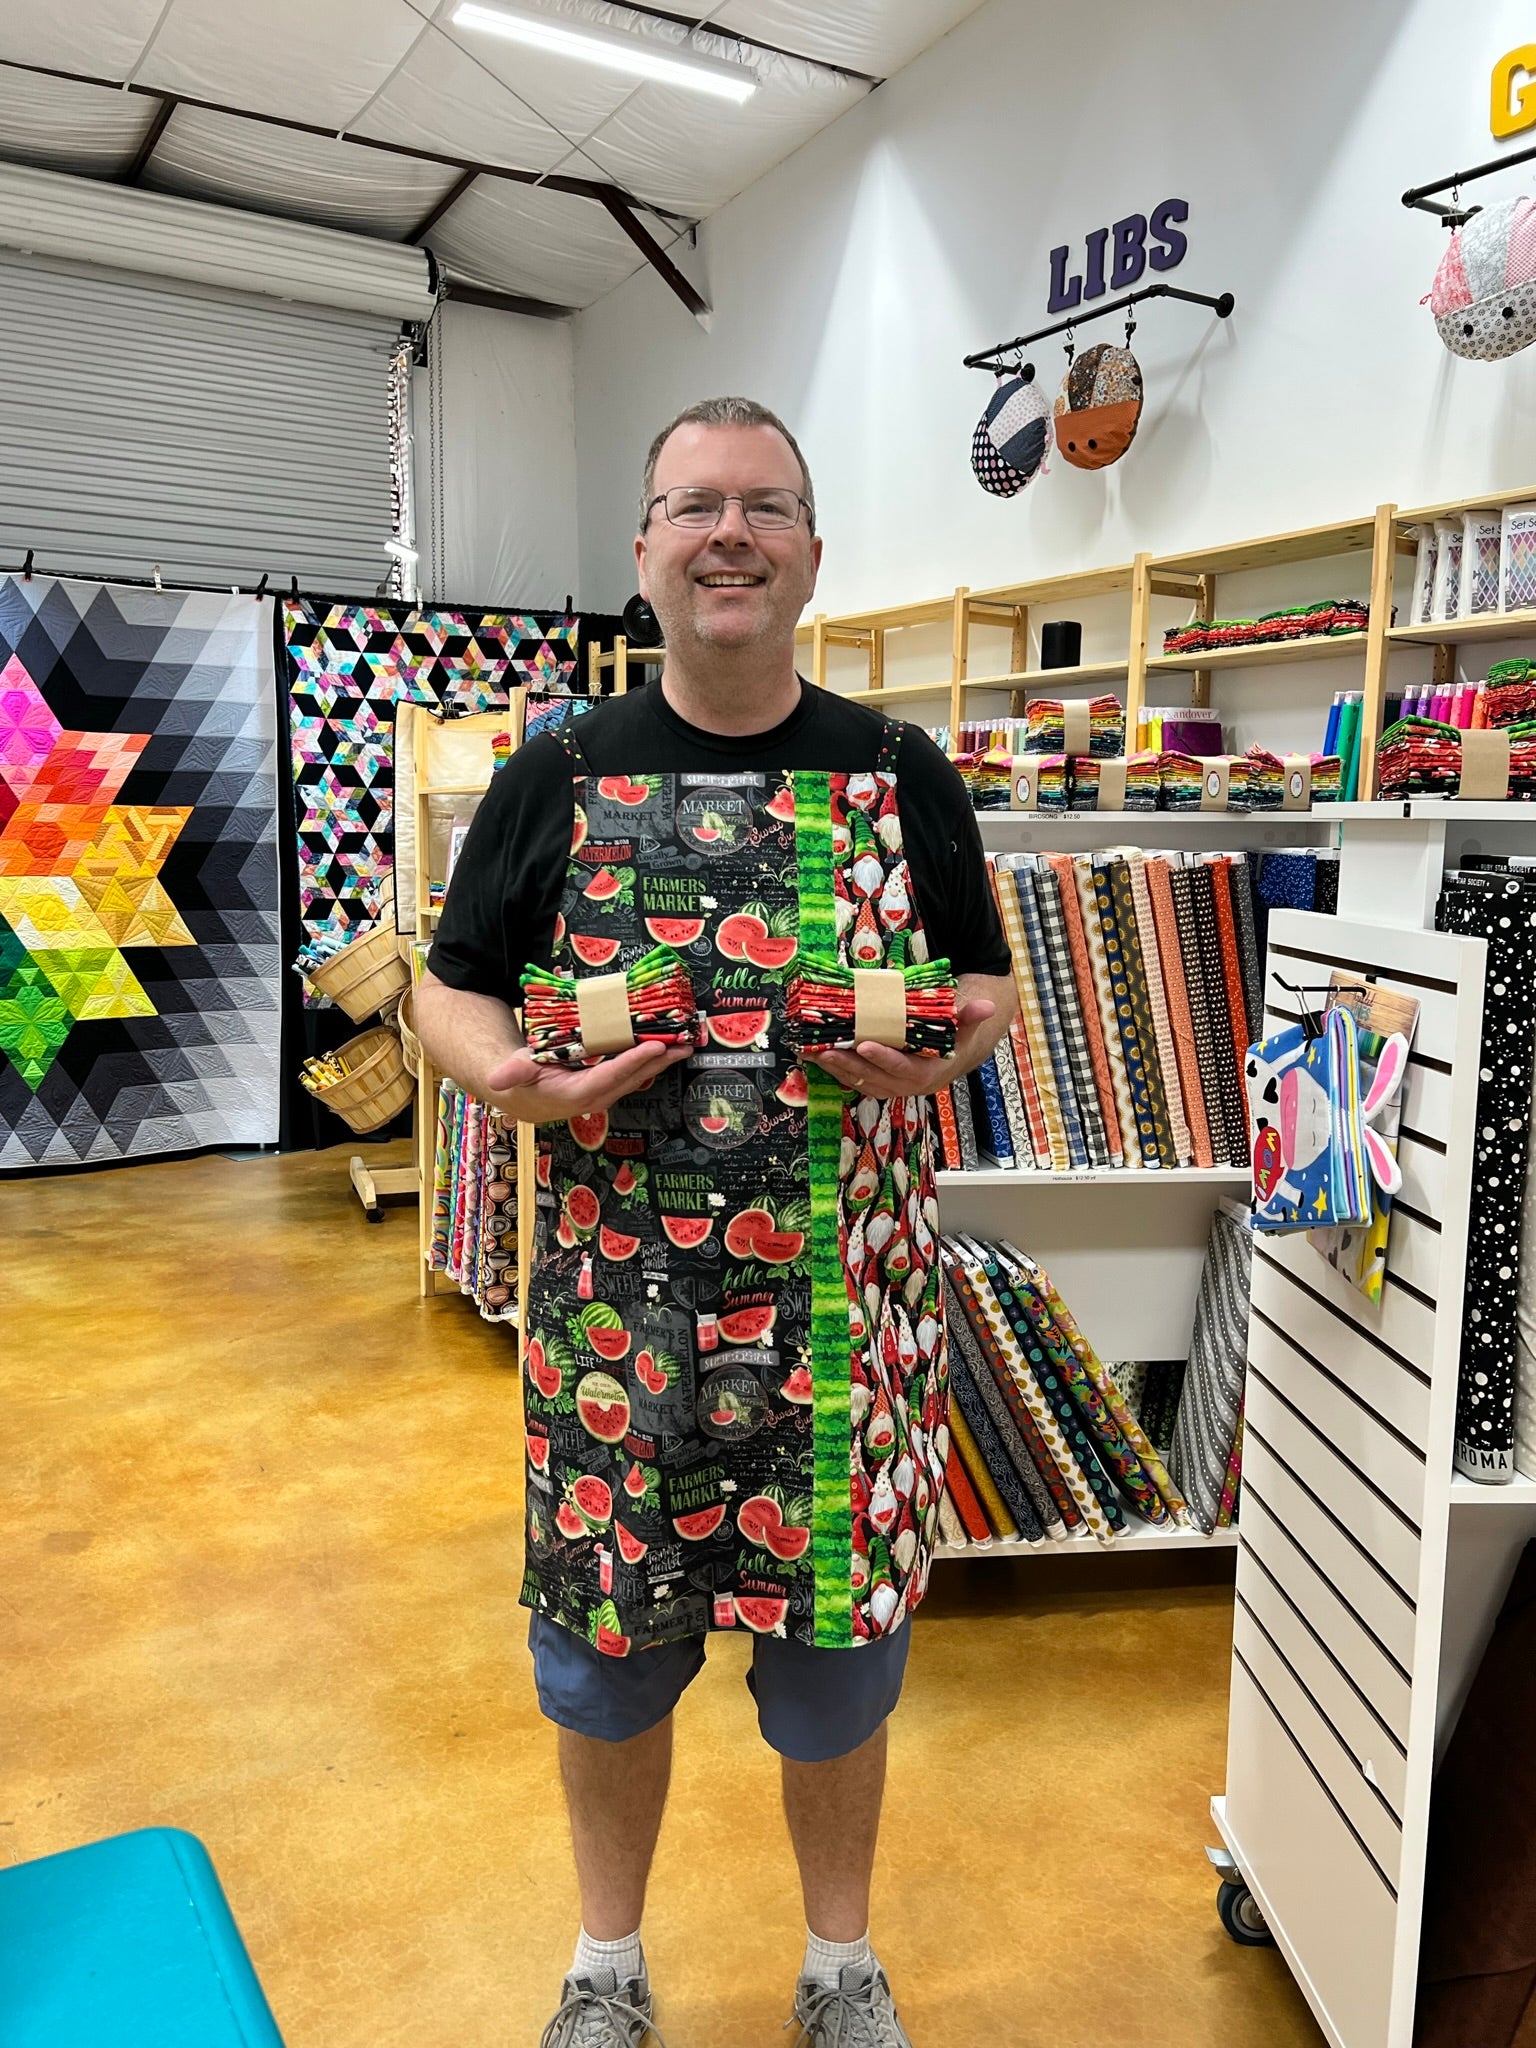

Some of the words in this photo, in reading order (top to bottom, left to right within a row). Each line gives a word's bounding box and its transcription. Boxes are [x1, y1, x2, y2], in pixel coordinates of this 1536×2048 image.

[1047, 198, 1189, 314] LIBS
[1173, 708, 1213, 719] andover
[603, 810, 656, 821] MARKET
[681, 799, 745, 815] MARKET
[750, 821, 785, 848] Sweet
[1494, 864, 1508, 872] STAR
[1508, 865, 1531, 873] SOCIETY
[643, 876, 707, 893] FARMERS
[1467, 878, 1486, 887] SOCIETY
[713, 988, 769, 1009] Summer
[688, 1084, 755, 1102] MARKET
[760, 1108, 795, 1137] Sweet
[655, 1173, 715, 1190] FARMERS
[722, 1290, 775, 1310] Summer
[580, 1385, 626, 1403] Watermelon
[701, 1378, 760, 1404] MARKET
[668, 1463, 726, 1494] FARMERS
[738, 1569, 787, 1598] Summer
